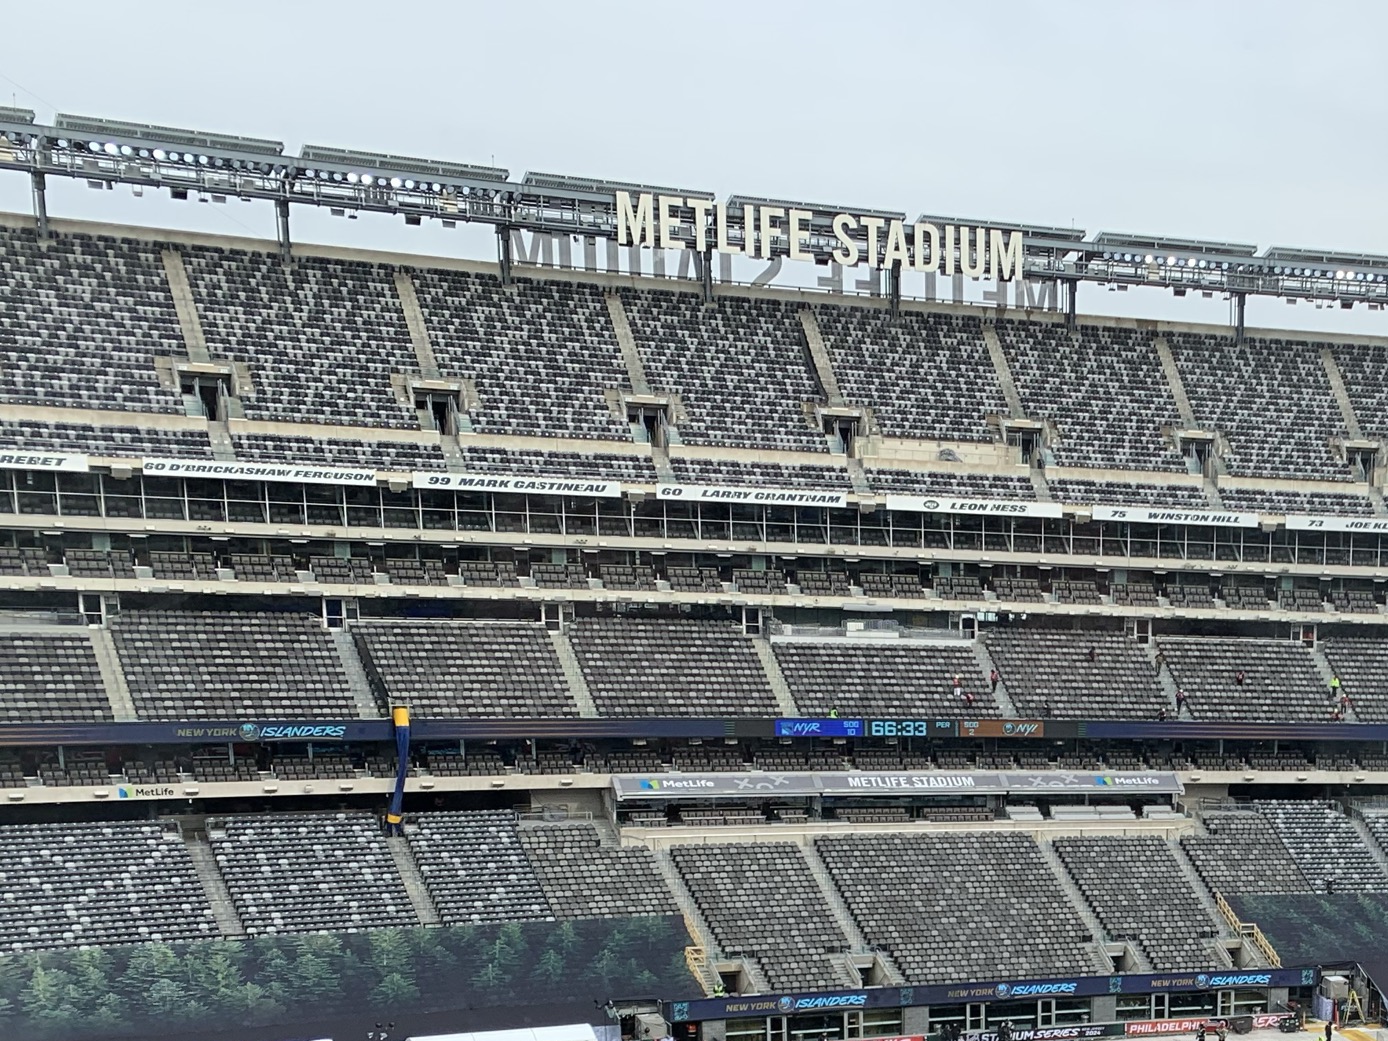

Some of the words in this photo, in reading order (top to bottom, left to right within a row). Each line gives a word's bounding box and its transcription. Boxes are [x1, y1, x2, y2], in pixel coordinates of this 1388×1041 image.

[616, 191, 815, 262] METLIFE
[832, 213, 1024, 281] STADIUM
[0, 455, 67, 467] REBET
[144, 462, 166, 472] 60
[169, 463, 292, 477] D'BRICKASHAW
[294, 469, 375, 482] FERGUSON
[428, 476, 451, 485] 99
[458, 477, 510, 489] MARK
[514, 480, 607, 493] GASTINEAU
[661, 487, 683, 497] 60
[701, 489, 751, 500] LARRY
[754, 491, 841, 504] GRANTHAM
[950, 502, 988, 512] LEON
[990, 503, 1028, 514] HESS
[1110, 510, 1128, 518] 75
[1147, 511, 1210, 523] WINSTON
[1212, 514, 1241, 524] HILL
[1307, 519, 1324, 528] 73
[1345, 521, 1371, 530] JOE
[793, 722, 821, 735] NYR
[871, 721, 927, 736] 66:33
[936, 721, 950, 729] PER
[1016, 723, 1038, 736] NYI
[177, 728, 204, 737] NEW
[206, 728, 237, 737] YORK
[260, 726, 346, 738] ISLANDERS
[969, 728, 974, 736] 2
[662, 779, 714, 789] MetLife
[848, 776, 908, 788] METLIFE
[913, 776, 975, 788] STADIUM
[1114, 776, 1159, 786] MetLife
[135, 786, 174, 797] MetLife
[1151, 980, 1172, 988] NEW
[1173, 978, 1194, 987] YORK
[1210, 974, 1271, 986] ISLANDERS
[948, 989, 967, 998] NEW
[970, 987, 994, 997] YORK
[1011, 983, 1077, 996] ISLANDERS
[726, 1003, 748, 1012] NEW
[750, 1001, 776, 1011] YORK
[795, 995, 867, 1008] ISLANDERS
[1034, 1028, 1080, 1039] SERIES
